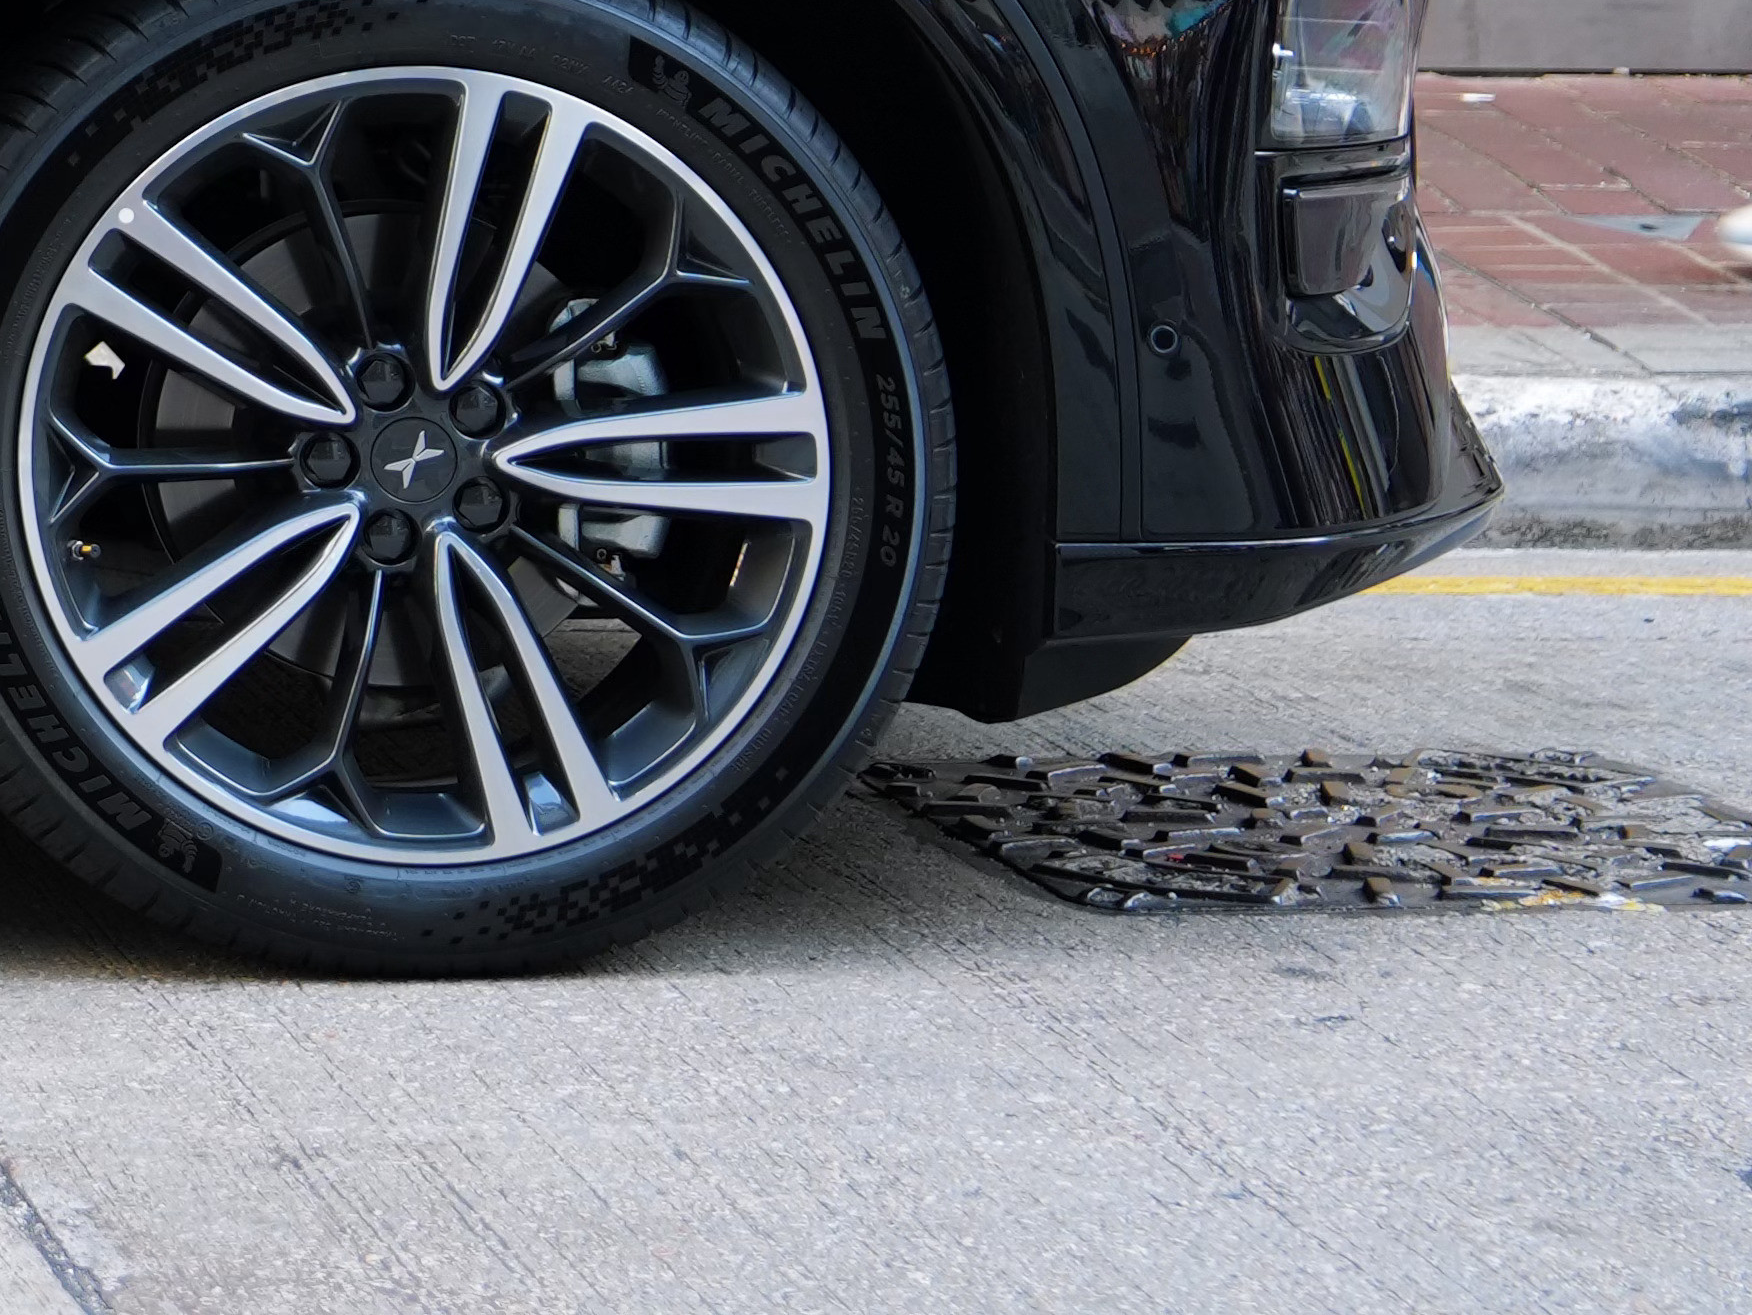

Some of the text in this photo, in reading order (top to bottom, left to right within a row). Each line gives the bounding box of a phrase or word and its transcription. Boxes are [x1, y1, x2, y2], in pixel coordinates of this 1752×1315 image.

[696, 84, 886, 349] MICHELIN
[872, 369, 906, 569] 255/45 R 20
